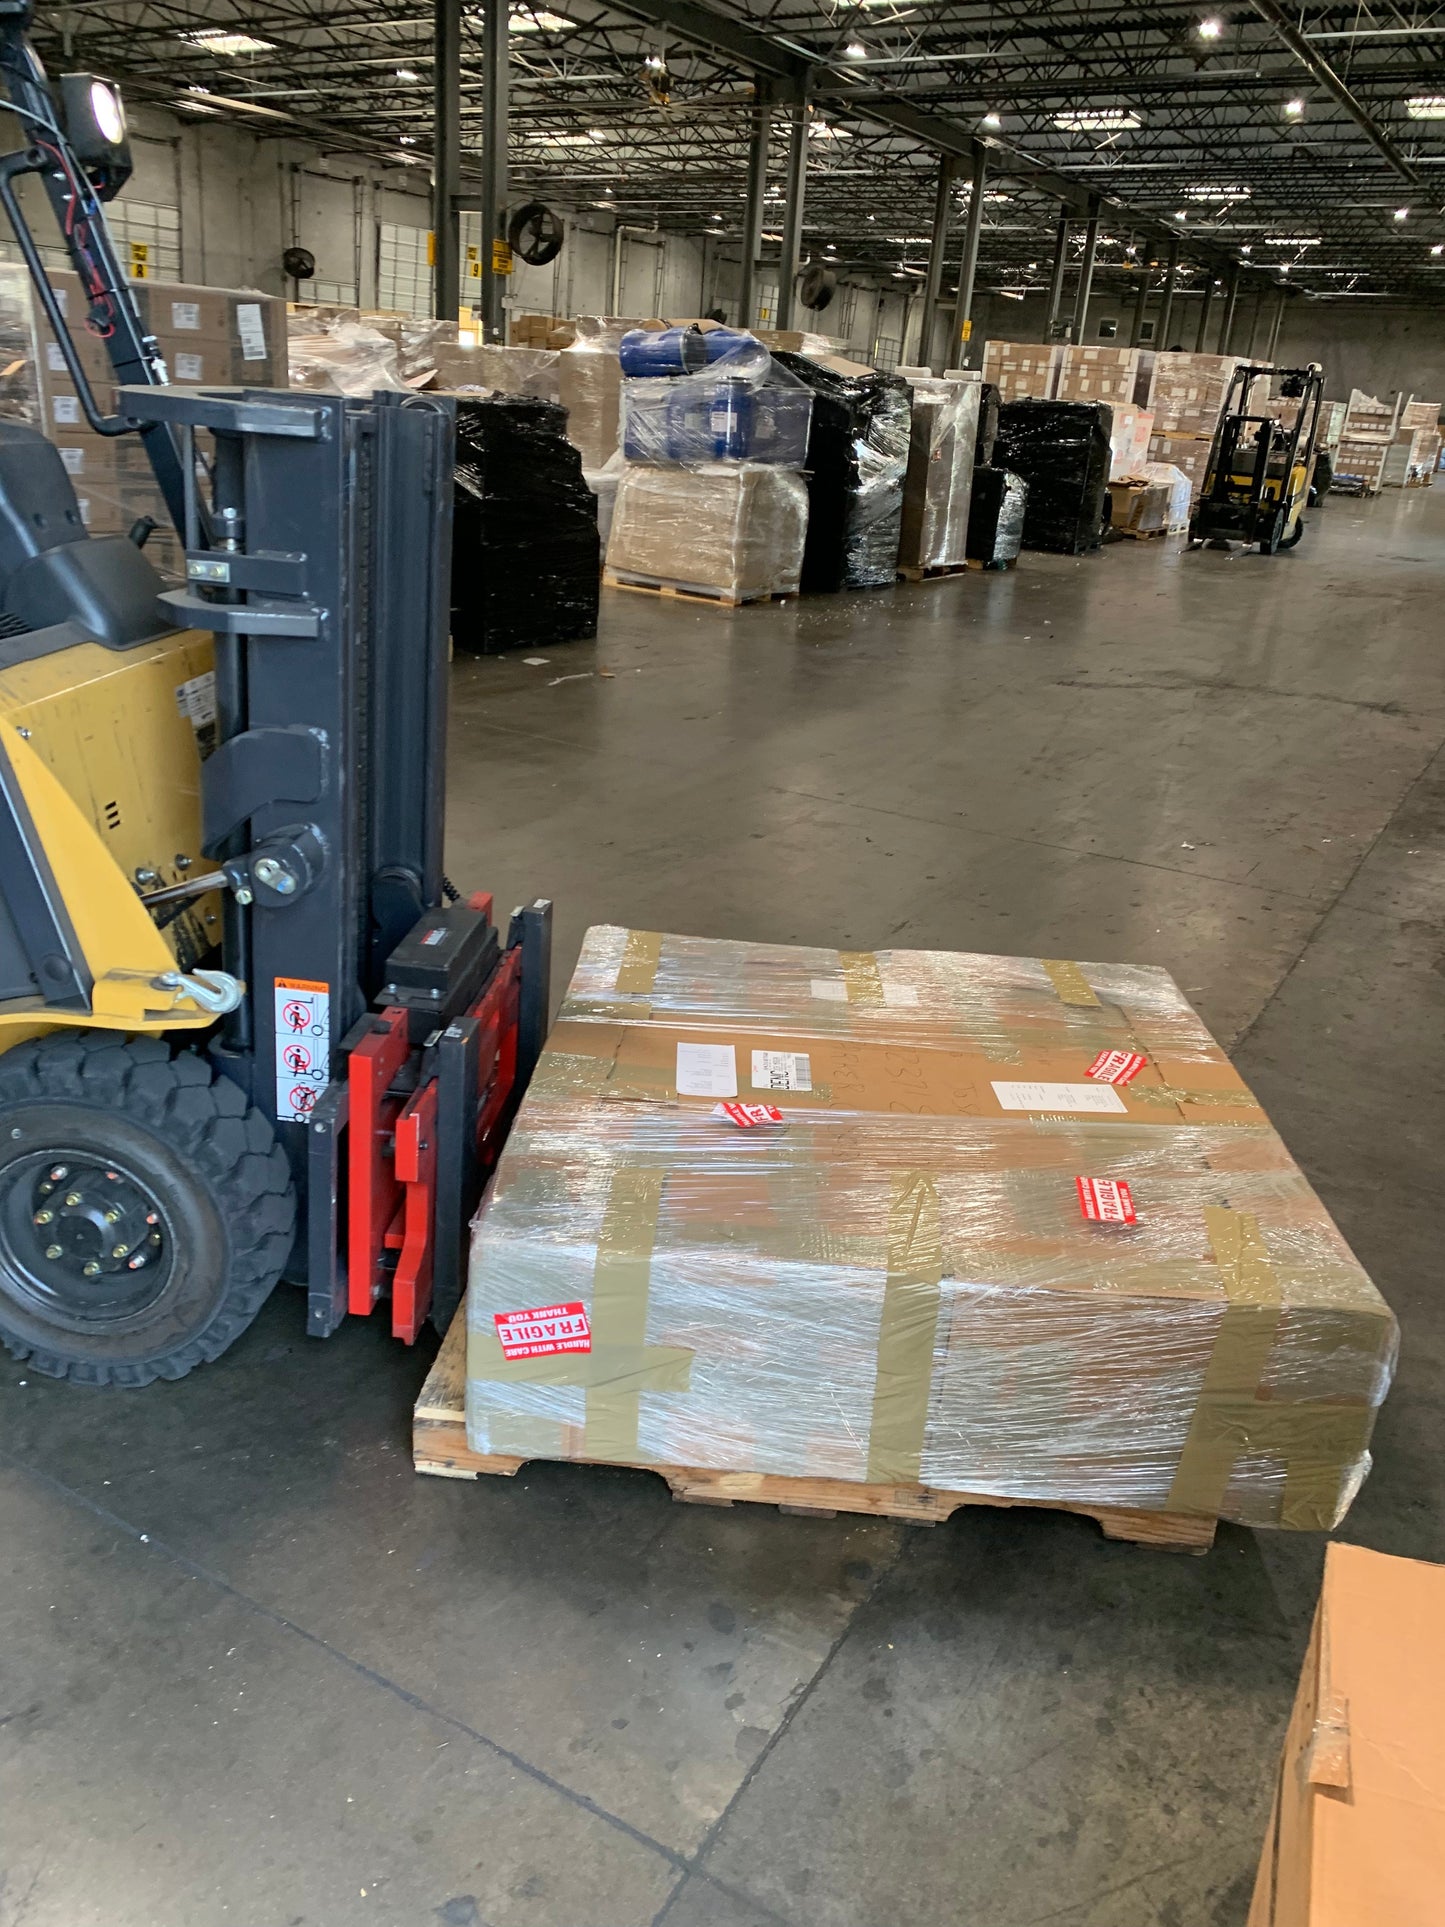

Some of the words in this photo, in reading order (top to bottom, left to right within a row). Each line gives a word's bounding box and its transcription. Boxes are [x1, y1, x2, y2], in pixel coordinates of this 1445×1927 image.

[288, 983, 327, 993] WARNING
[1097, 1052, 1129, 1081] FRAGILE
[1098, 1180, 1119, 1220] FRAGILE
[508, 1313, 530, 1323] YOU
[532, 1307, 568, 1319] THANK
[501, 1319, 586, 1341] FRAGILE
[531, 1345, 556, 1354] WITH
[556, 1339, 590, 1350] HANDLE
[505, 1347, 530, 1357] CARE
